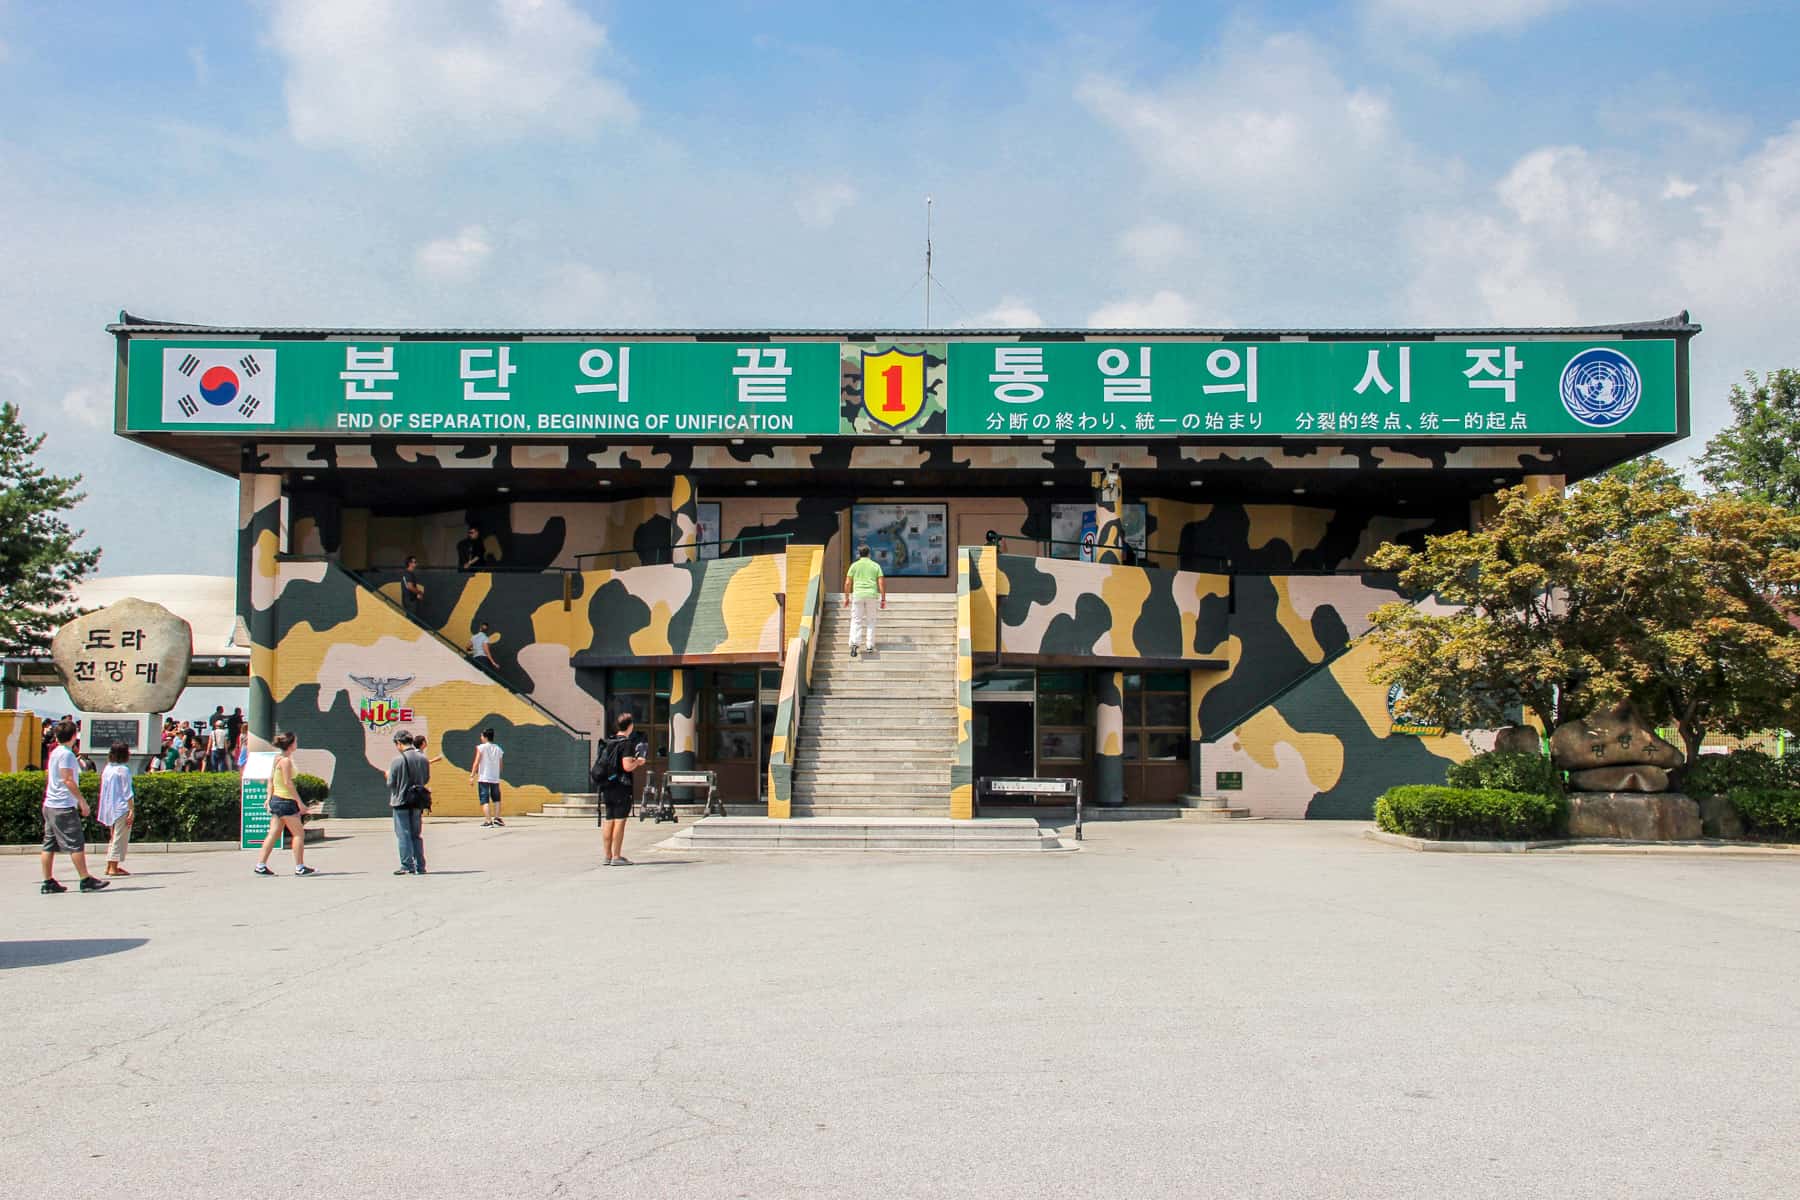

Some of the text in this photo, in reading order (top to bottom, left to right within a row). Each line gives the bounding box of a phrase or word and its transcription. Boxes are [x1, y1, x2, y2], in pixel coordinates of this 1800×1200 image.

[339, 346, 793, 403] 분단의 끝
[988, 346, 1523, 403] 통일의 시작
[881, 365, 906, 412] 1
[337, 413, 793, 432] END OF SEPARATION, BEGINNING OF UNIFICATION
[986, 412, 1262, 430] 分断の終わり、統一の始まり
[1295, 411, 1528, 430] 分裂的终点、统一的起点
[85, 629, 146, 650] 도라
[74, 660, 158, 684] 전망대
